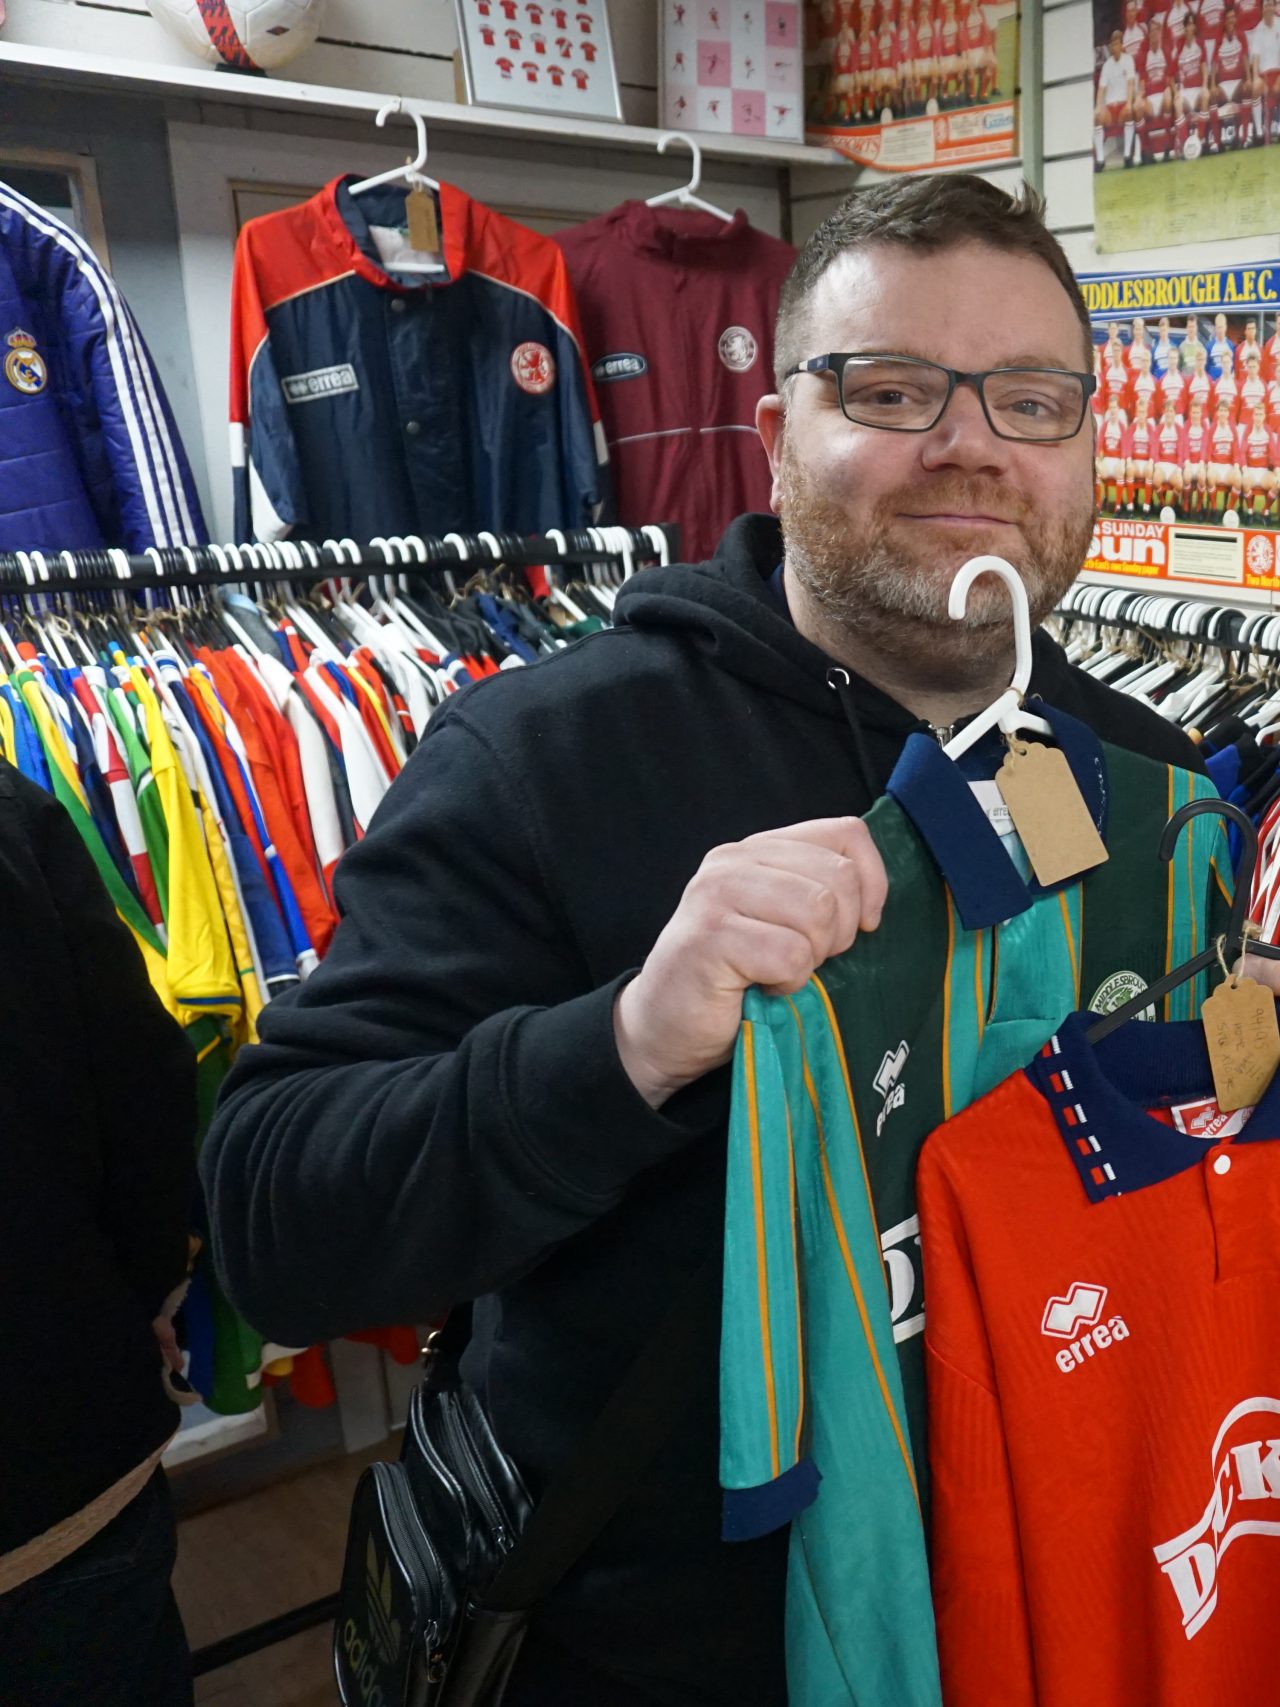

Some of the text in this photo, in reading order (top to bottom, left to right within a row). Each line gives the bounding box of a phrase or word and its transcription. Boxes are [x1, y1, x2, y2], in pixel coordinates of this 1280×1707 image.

[1081, 272, 1220, 311] IDDLESBROUGH
[1102, 521, 1165, 538] SUNDAY
[1246, 573, 1260, 585] Two
[1094, 974, 1147, 1012] MIDDLESBROUG
[344, 1619, 383, 1707] adida
